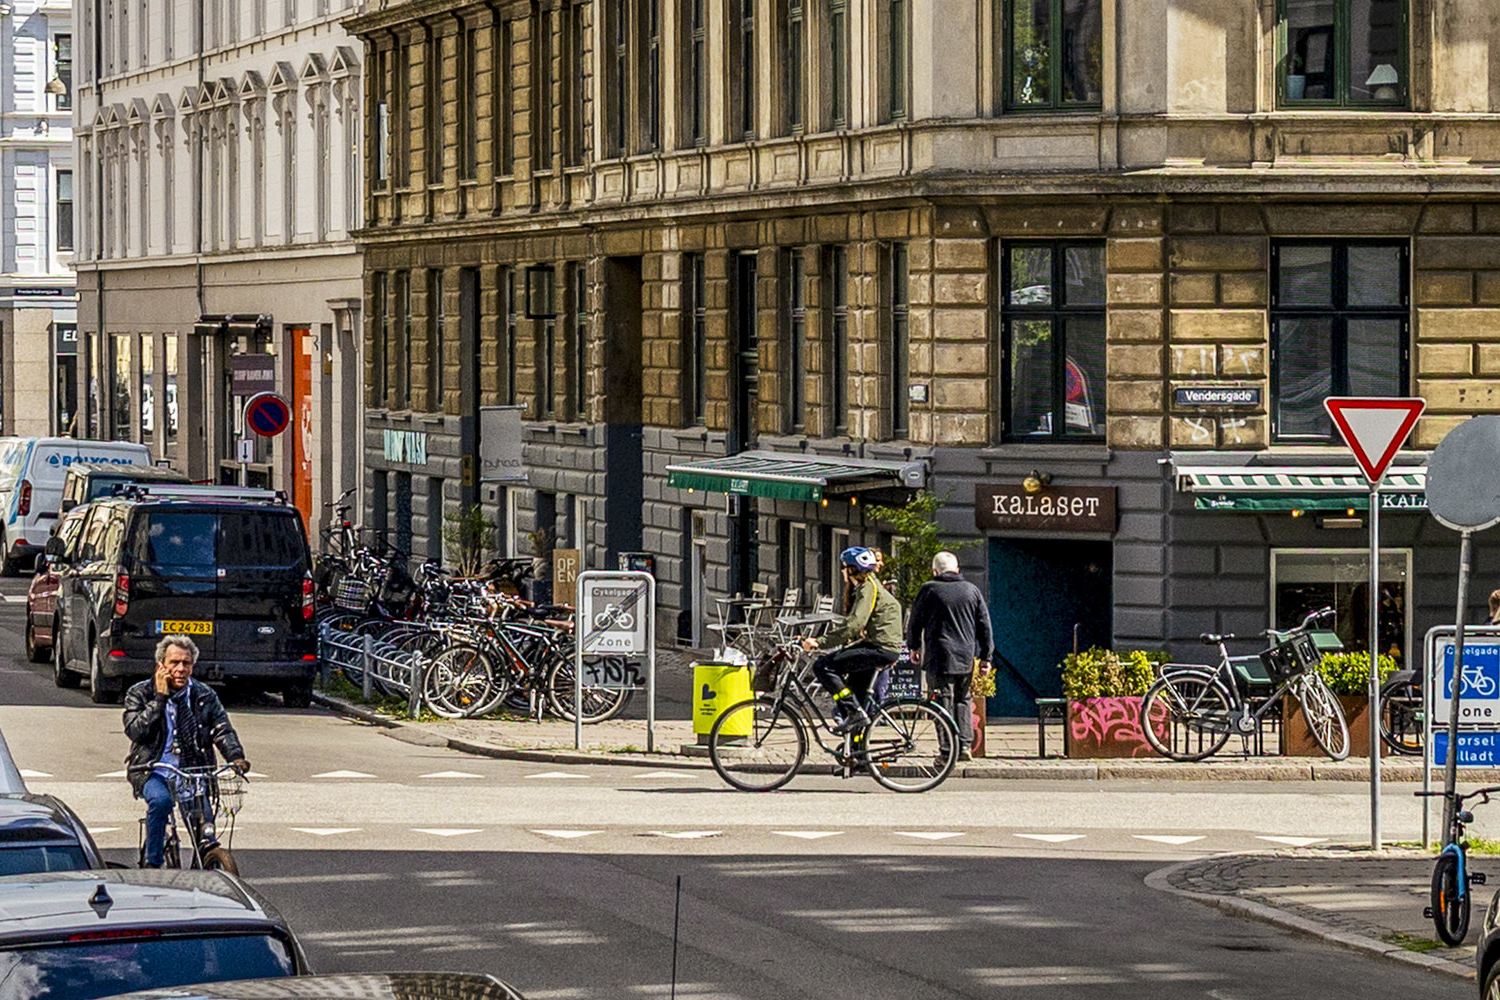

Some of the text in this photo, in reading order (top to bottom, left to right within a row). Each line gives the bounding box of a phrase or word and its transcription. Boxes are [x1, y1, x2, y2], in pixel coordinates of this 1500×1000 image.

[1185, 390, 1252, 402] Vendersgade
[557, 557, 576, 570] OP
[557, 569, 576, 583] EN
[163, 622, 212, 633] EC 24 783
[598, 637, 632, 648] Zone
[1446, 646, 1499, 656] Celgade
[1461, 707, 1493, 718] one
[1457, 735, 1496, 747] ørsel
[1457, 750, 1494, 762] lladt
